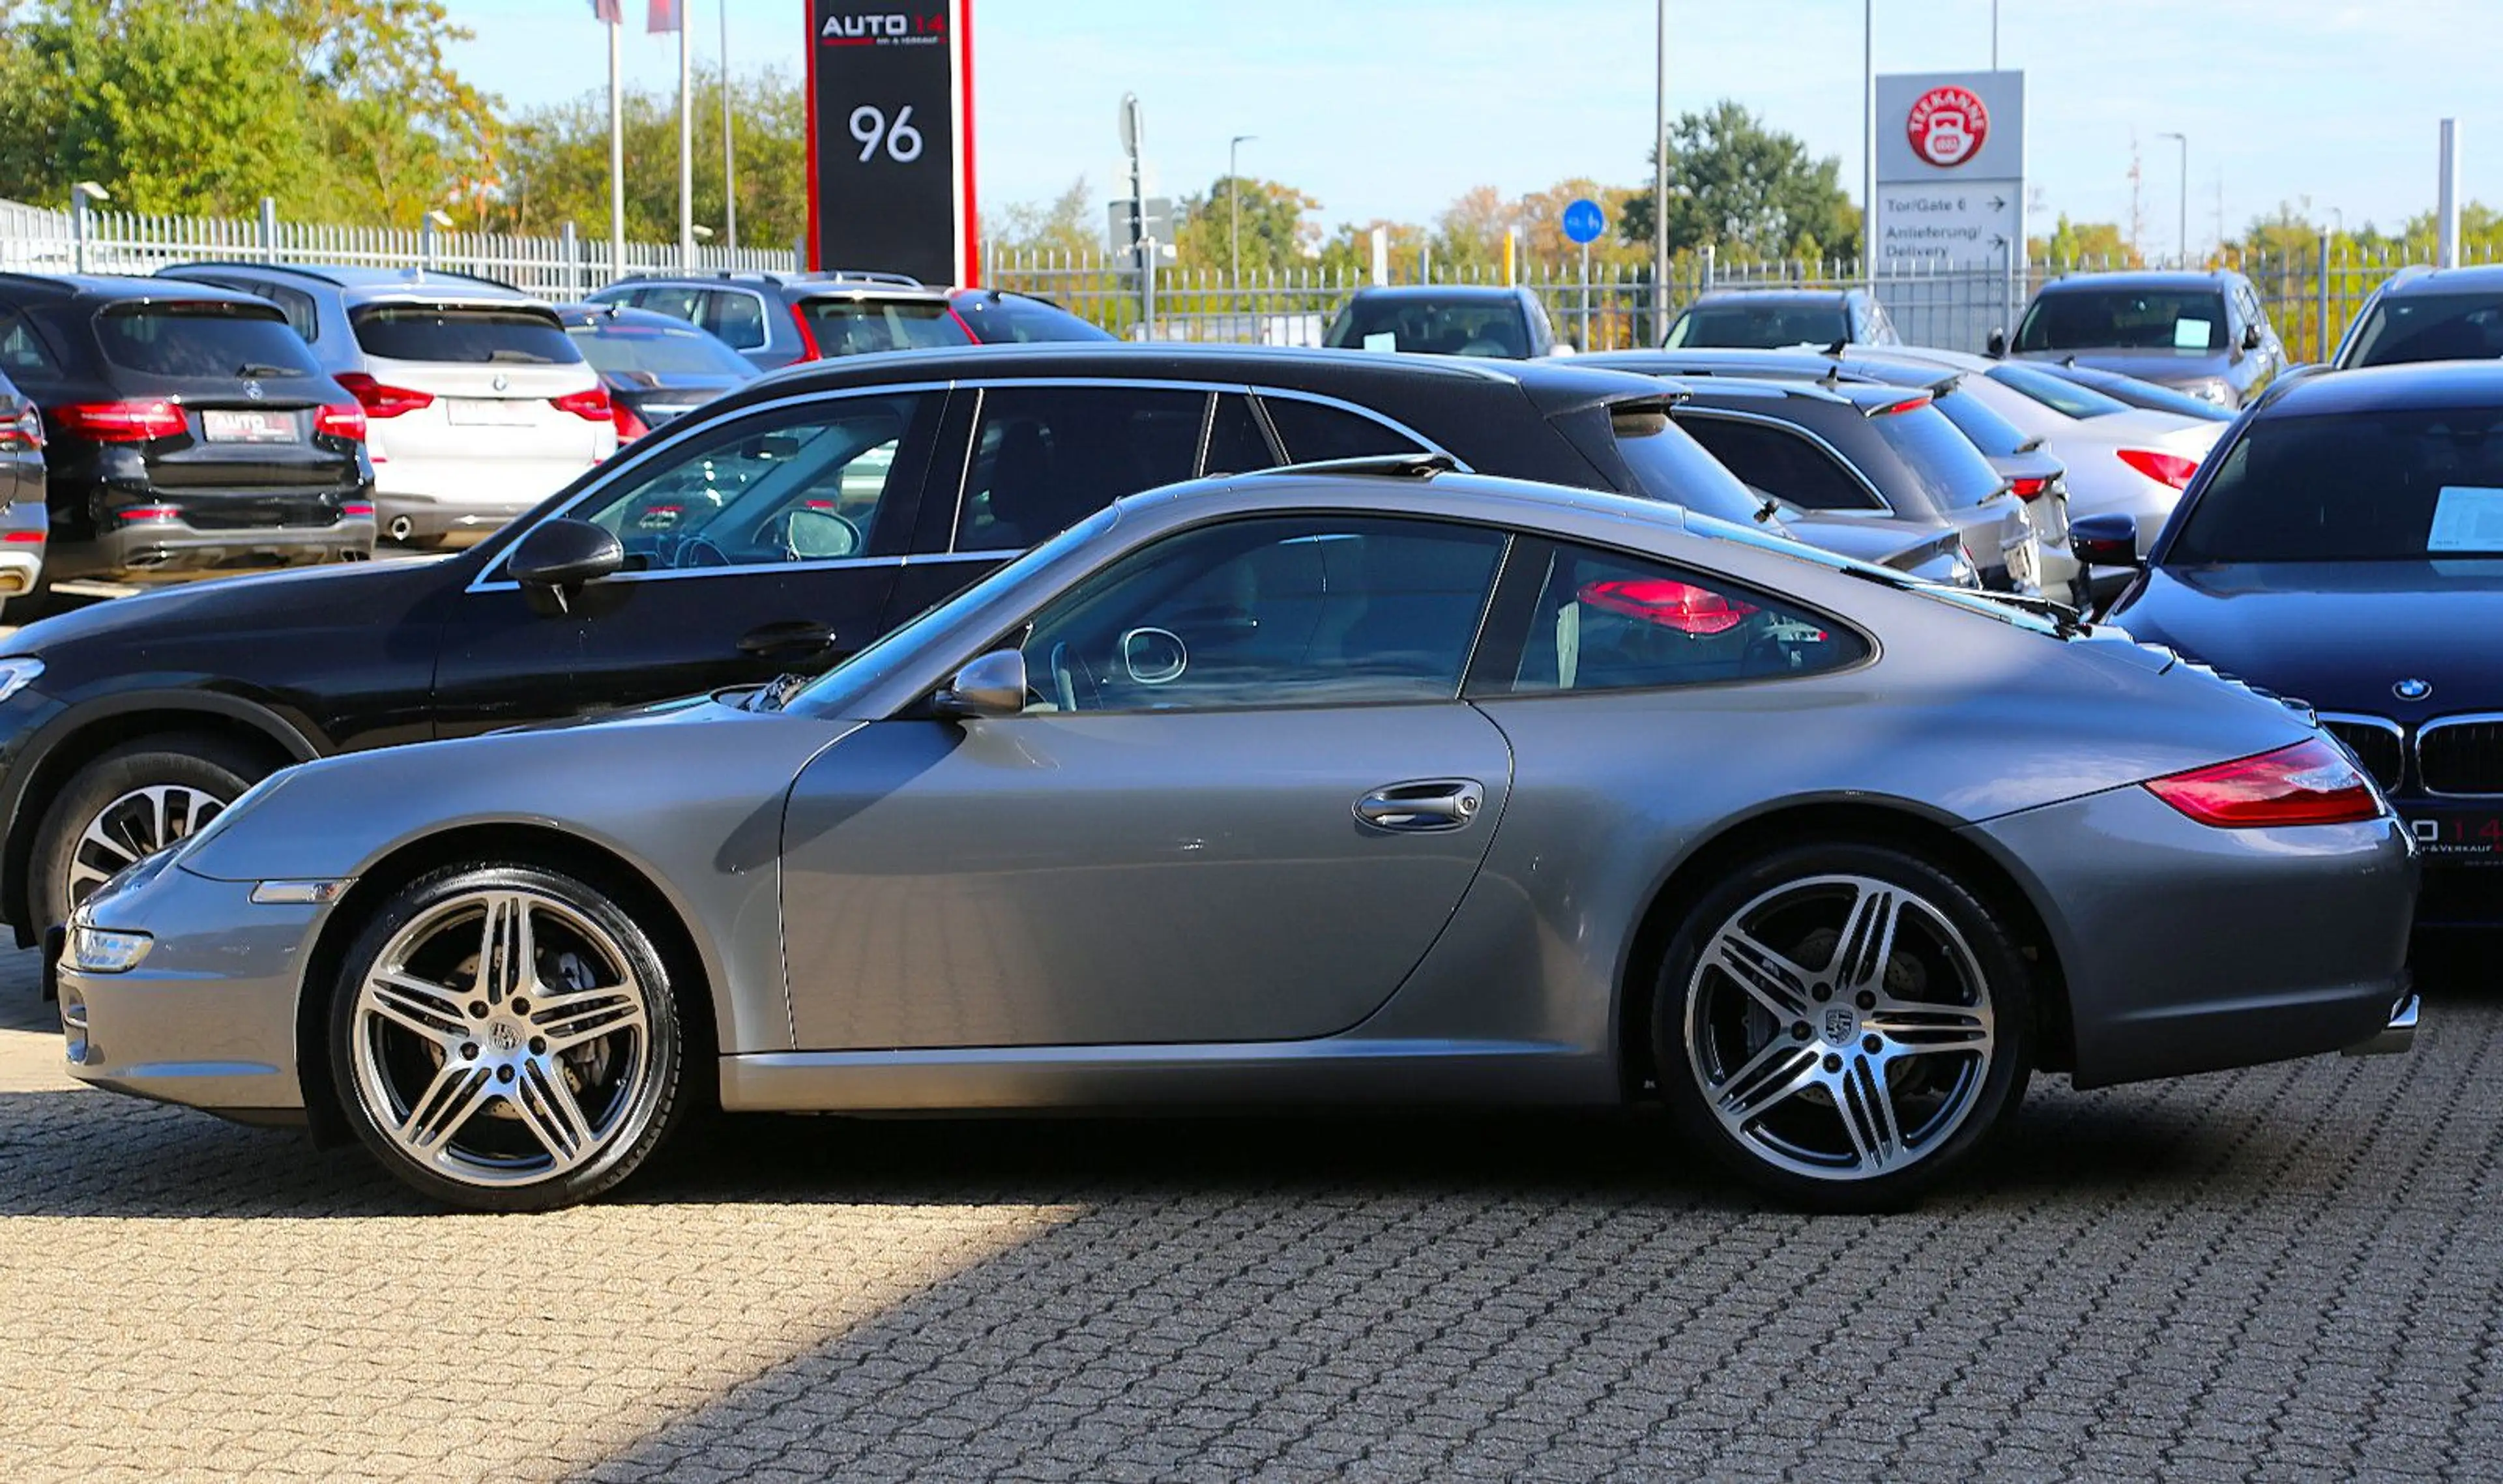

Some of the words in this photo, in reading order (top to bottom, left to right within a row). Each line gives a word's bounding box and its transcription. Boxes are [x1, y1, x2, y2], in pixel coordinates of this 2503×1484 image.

[821, 14, 907, 36] AUTO
[915, 13, 945, 34] 14
[849, 105, 922, 162] 96
[1886, 244, 1949, 259] Delivery
